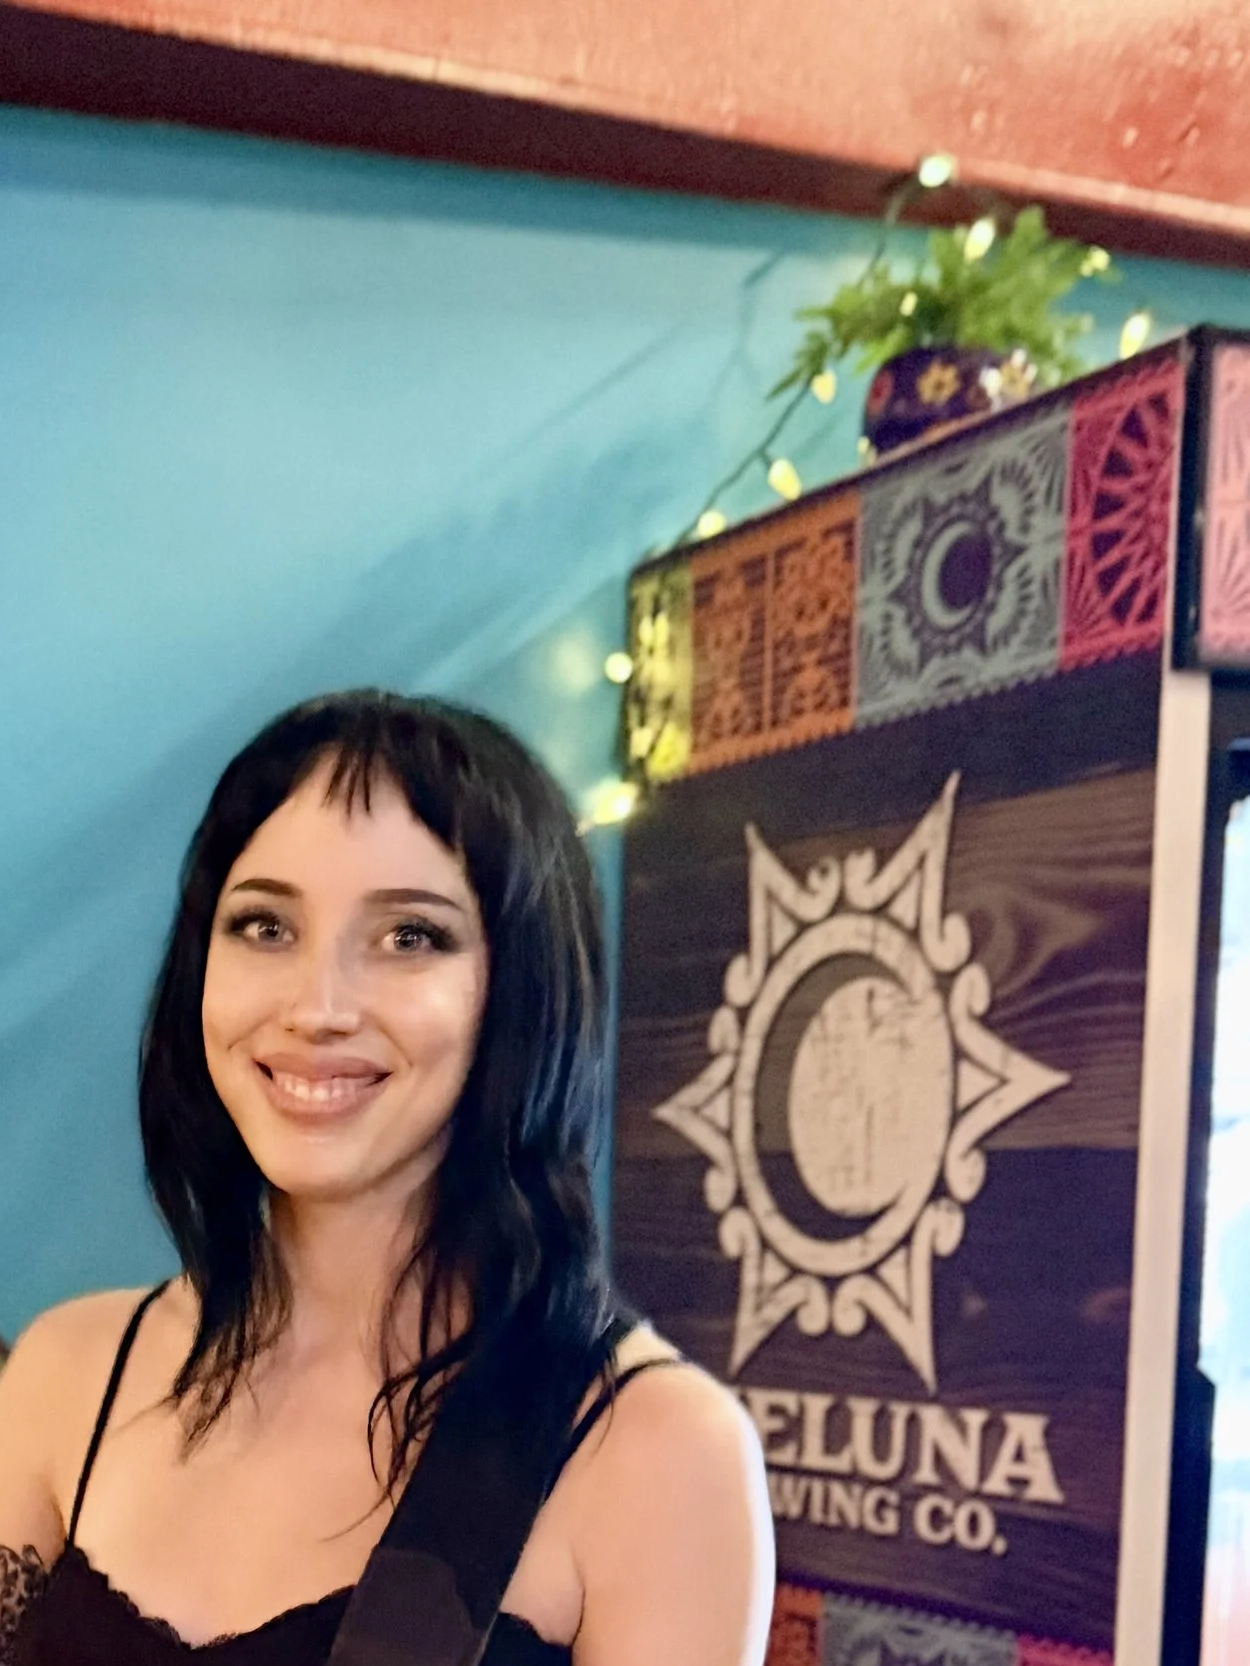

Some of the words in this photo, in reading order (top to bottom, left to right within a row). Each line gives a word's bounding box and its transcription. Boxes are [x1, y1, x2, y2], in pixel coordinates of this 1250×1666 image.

[740, 1386, 1065, 1504] ELUNA
[767, 1474, 900, 1536] WING
[913, 1494, 1008, 1557] CO.
